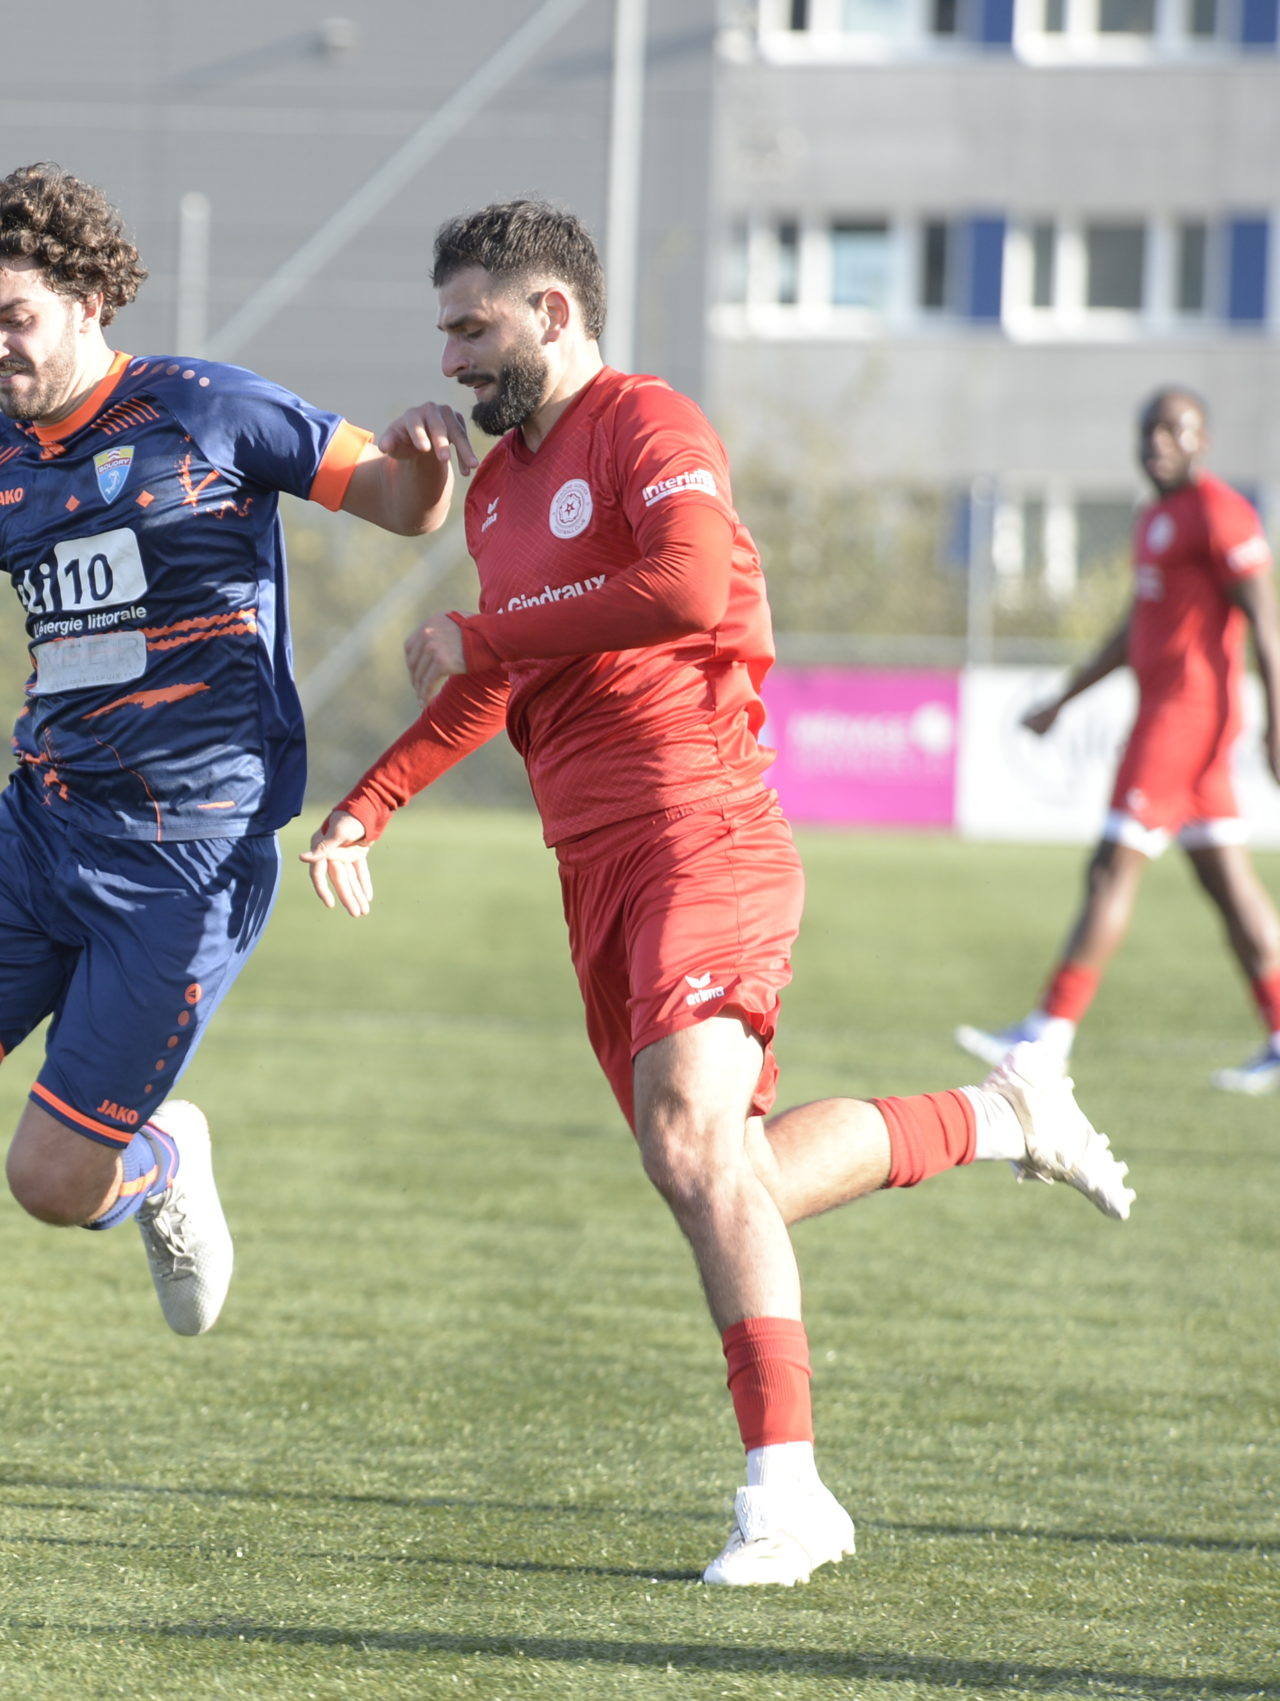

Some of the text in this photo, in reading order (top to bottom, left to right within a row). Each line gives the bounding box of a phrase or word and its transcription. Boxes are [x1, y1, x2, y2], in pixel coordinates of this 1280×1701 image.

[98, 459, 131, 473] BOUDRY
[87, 606, 147, 630] littorale
[97, 1099, 139, 1125] JAKO
